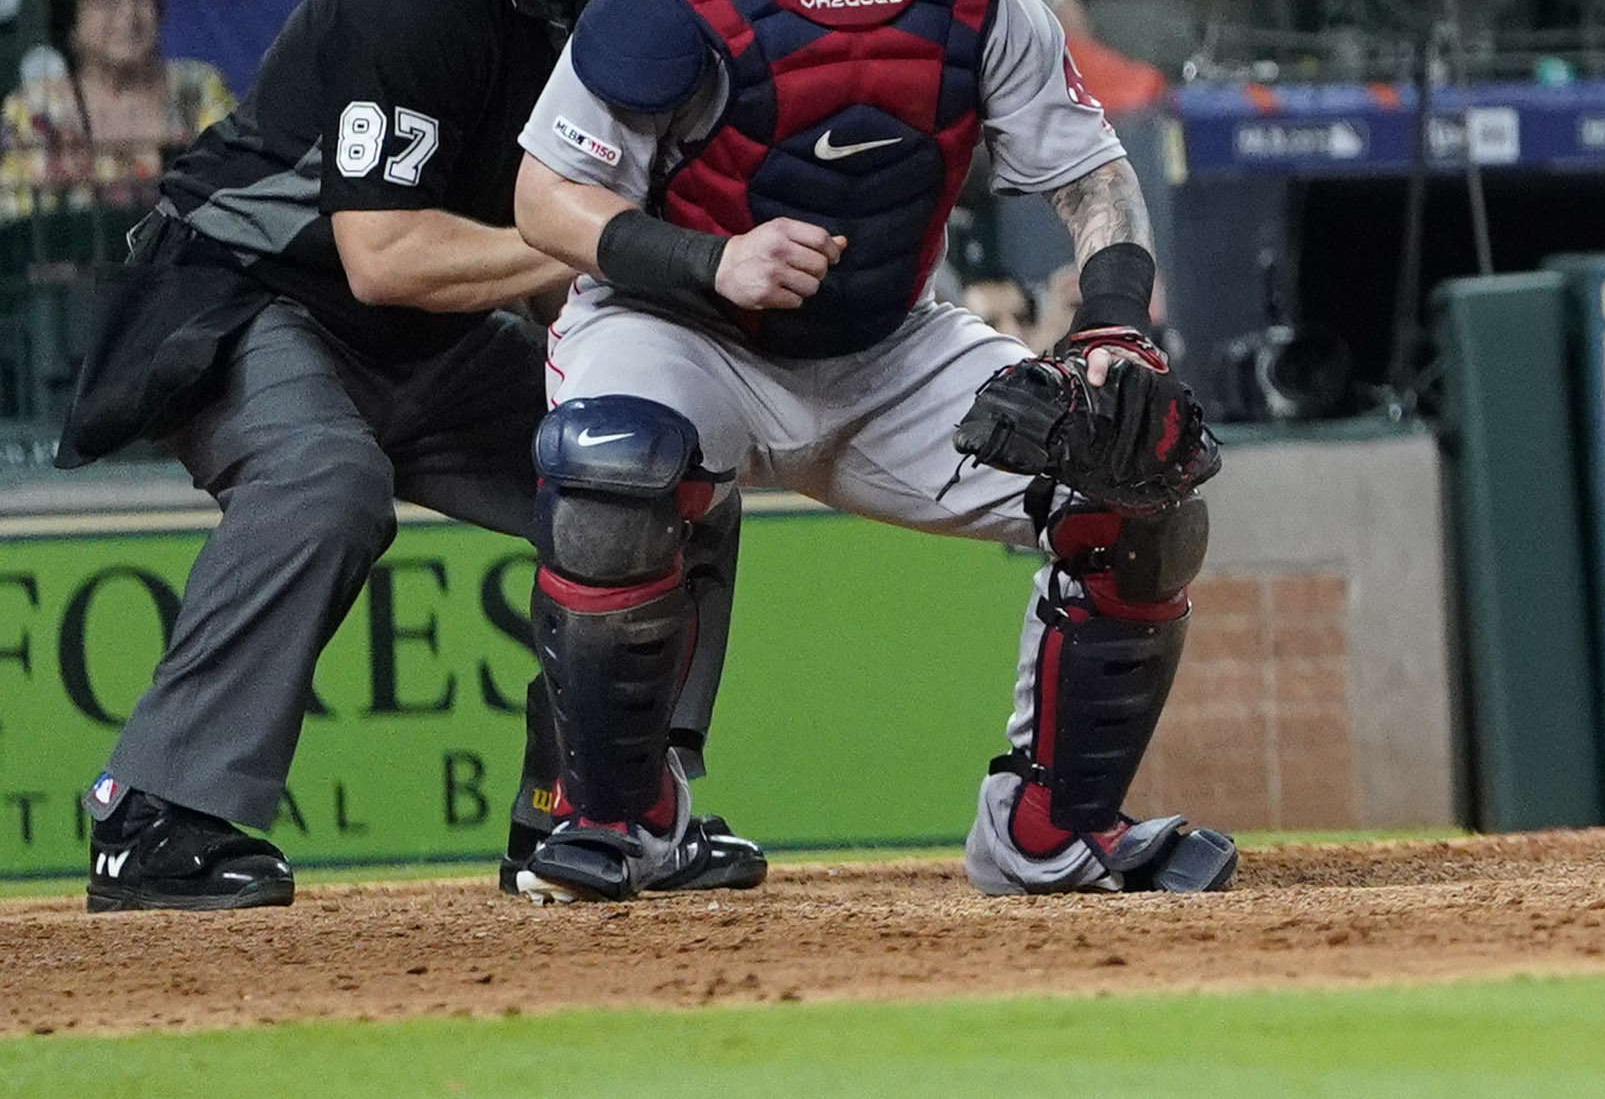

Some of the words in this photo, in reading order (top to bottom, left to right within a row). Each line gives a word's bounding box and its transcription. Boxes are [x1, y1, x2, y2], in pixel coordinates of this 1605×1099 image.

[337, 101, 439, 186] 87
[555, 120, 579, 141] MLB
[594, 143, 617, 162] 150
